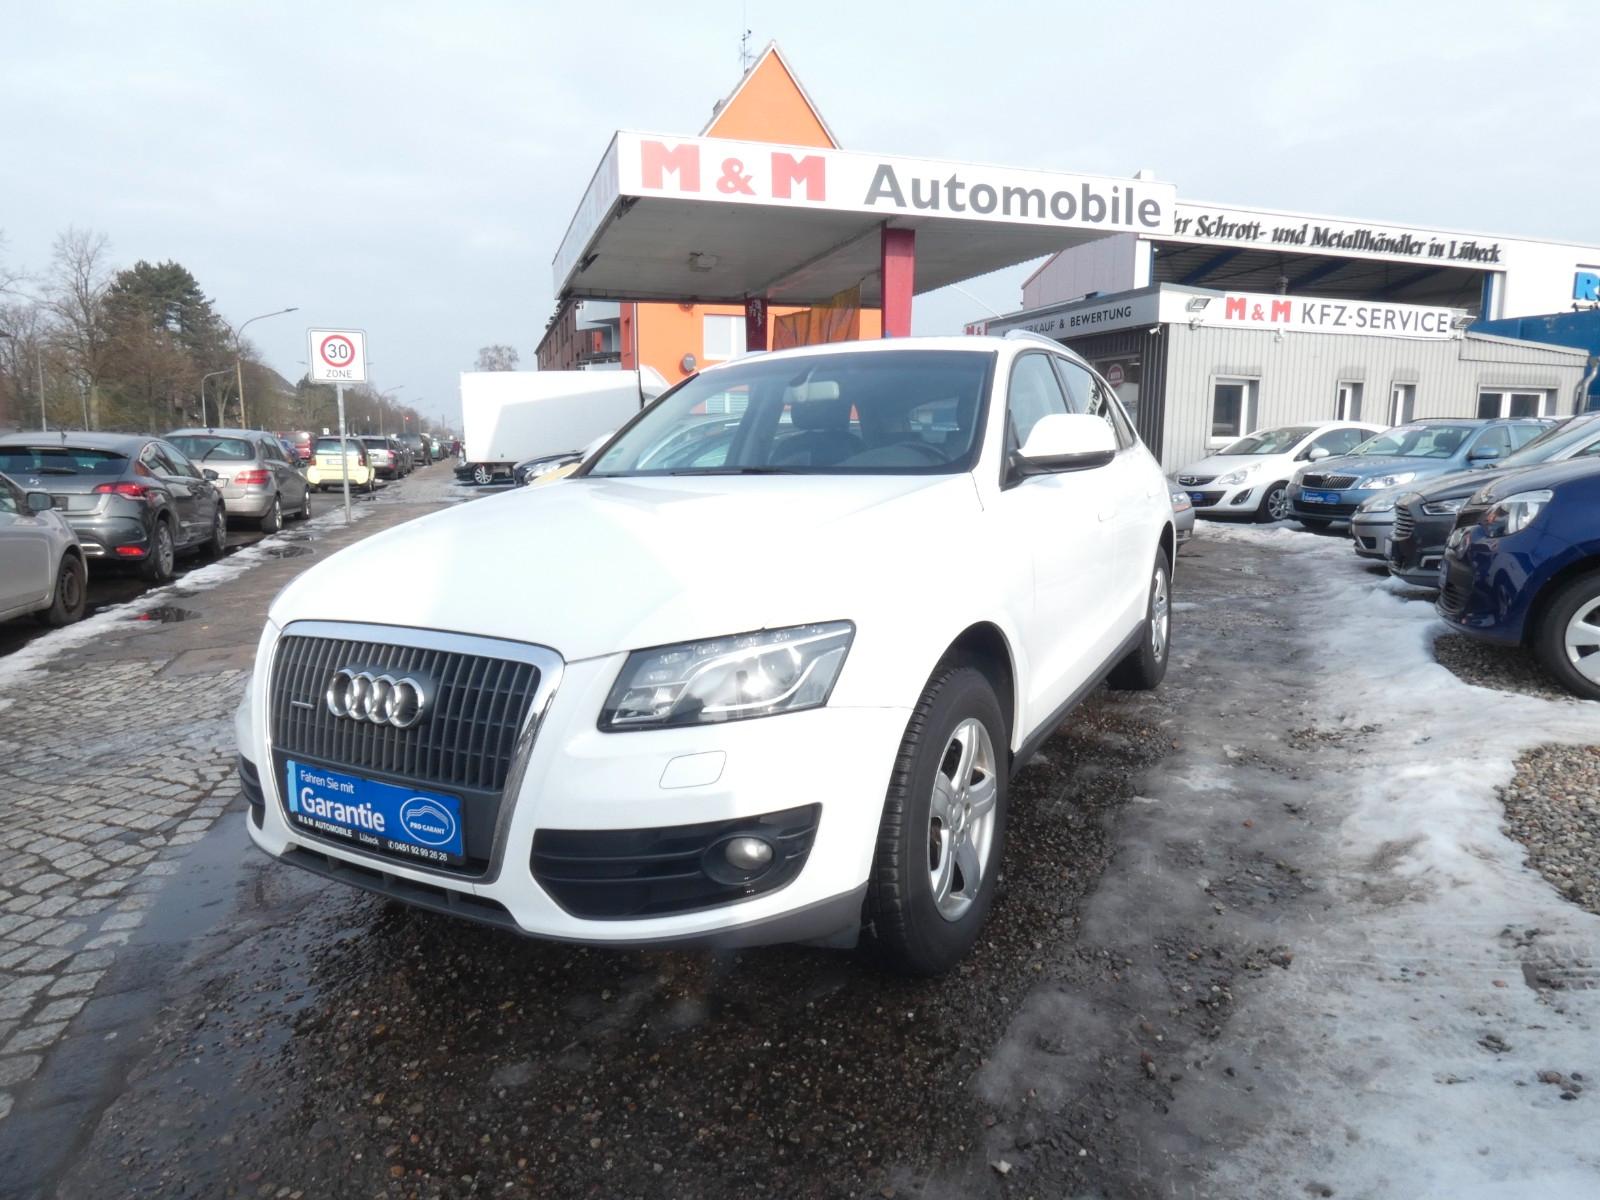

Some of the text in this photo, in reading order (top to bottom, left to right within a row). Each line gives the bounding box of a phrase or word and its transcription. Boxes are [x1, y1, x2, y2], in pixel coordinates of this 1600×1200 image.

[640, 140, 1161, 228] M & M Automobile
[1195, 214, 1268, 241] Schrott-
[1271, 223, 1309, 245] und
[1310, 225, 1427, 256] Metallhändler
[1428, 236, 1447, 258] in
[1448, 239, 1502, 264] Lübeck
[1059, 318, 1065, 329] &
[1070, 306, 1132, 327] BEWERTUNG
[1225, 296, 1247, 321] M
[1251, 303, 1265, 322] &
[1271, 299, 1292, 323] M
[328, 343, 348, 359] 30
[326, 369, 352, 379] ZONE
[300, 769, 355, 795] Fahren Sie mit
[300, 787, 385, 833] Garantie
[315, 820, 353, 838] AUTOMOBILE
[359, 832, 379, 846] Lübeck
[409, 821, 445, 836] PRO GARANT
